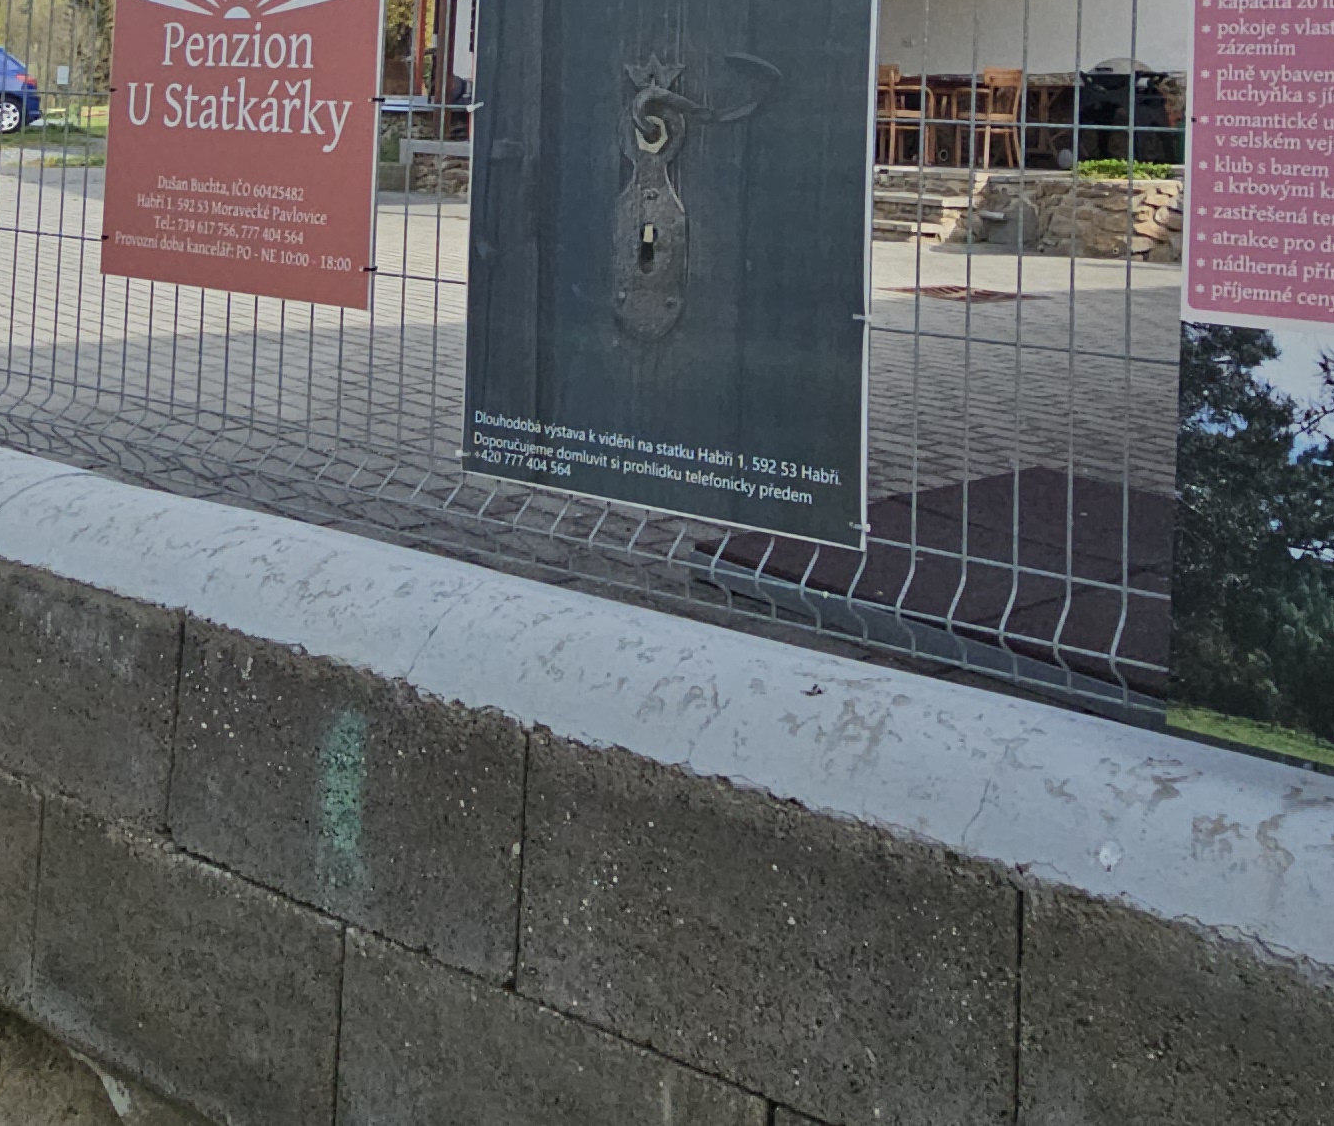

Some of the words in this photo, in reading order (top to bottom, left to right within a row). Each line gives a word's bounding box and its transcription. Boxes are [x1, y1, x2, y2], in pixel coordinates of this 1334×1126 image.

[1217, 19, 1276, 41] pokoje
[1281, 24, 1290, 35] s
[162, 22, 314, 69] Penzion
[1217, 39, 1296, 56] zázemím
[1216, 65, 1256, 86] plně
[1216, 83, 1303, 106] kuchyňka
[1307, 90, 1317, 104] s
[127, 83, 153, 125] U
[163, 77, 353, 153] Statkářky
[1215, 113, 1318, 130] romantické
[1215, 135, 1225, 148] v
[1230, 131, 1301, 150] selském
[1214, 156, 1254, 174] klub
[1257, 162, 1266, 174] s
[1271, 160, 1329, 178] barem
[157, 176, 188, 191] Dušan
[191, 178, 229, 196] Buchta,
[232, 179, 250, 197] IČO
[253, 185, 304, 201] 60425482
[1214, 181, 1223, 194] a
[1228, 178, 1314, 200] krbovými
[177, 199, 194, 212] 592
[197, 200, 209, 213] 53
[211, 202, 270, 220] Moravecké
[273, 208, 327, 225] Pavlovice
[1213, 205, 1307, 224] zastřešená
[177, 219, 195, 233] 739
[197, 221, 215, 234] 617
[218, 223, 239, 239] 756,
[241, 225, 259, 239] 777
[262, 228, 281, 243] 404
[284, 230, 304, 244] 564
[1212, 231, 1279, 249] atrakce
[1283, 236, 1315, 254] pro
[160, 236, 184, 252] doba
[236, 245, 252, 260] PO
[261, 248, 277, 262] NE
[280, 251, 309, 267] 10:00
[320, 255, 352, 272] 18:00
[1212, 255, 1298, 276] nádherná
[1211, 281, 1292, 304] příjemné
[475, 410, 541, 433] Dlouhodobá
[544, 424, 585, 441] výstava
[589, 429, 596, 442] k
[598, 431, 634, 450] vidění
[637, 440, 653, 453] na
[657, 442, 695, 460] statku
[698, 448, 733, 466] Habří
[752, 456, 776, 474] 592
[781, 462, 797, 477] 53
[474, 449, 501, 463] +420
[505, 452, 523, 467] 777
[526, 457, 547, 472] 404
[551, 461, 571, 476] 564
[474, 432, 553, 458] Doporučujeme
[557, 448, 607, 468] domluvit
[611, 456, 619, 469] si
[686, 470, 756, 497] telefonicky
[759, 483, 812, 504] předem
